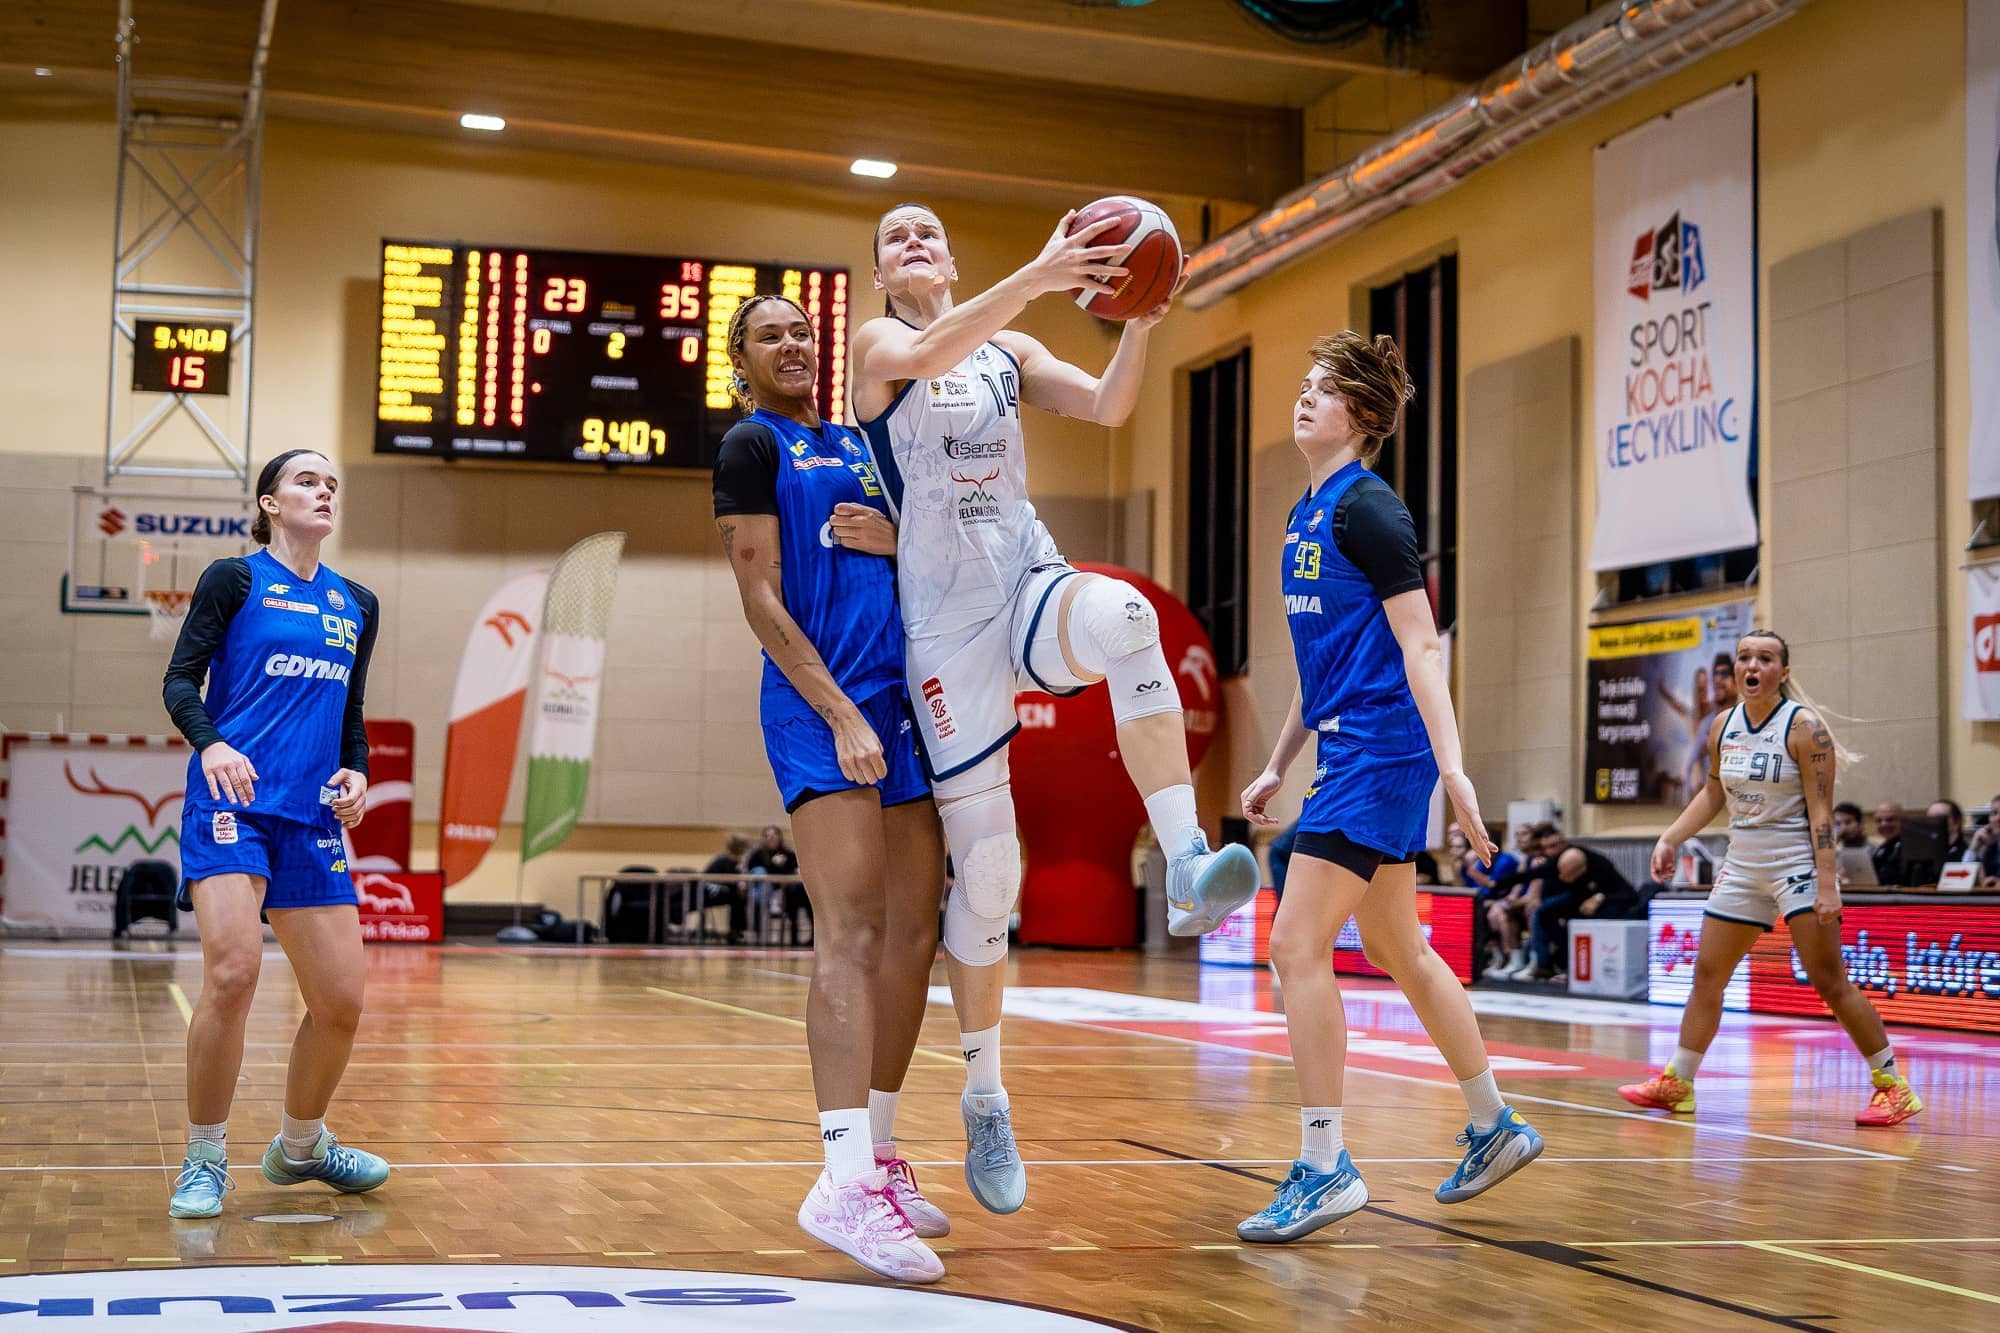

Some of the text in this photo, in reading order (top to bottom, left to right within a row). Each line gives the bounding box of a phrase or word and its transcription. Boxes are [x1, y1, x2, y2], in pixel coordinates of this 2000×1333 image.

[544, 277, 587, 313] 23
[660, 284, 700, 320] 35
[533, 328, 551, 354] 0
[607, 332, 625, 359] 2
[681, 337, 699, 363] 0
[1630, 302, 1711, 368] SPORT
[170, 356, 205, 389] 15
[1625, 357, 1713, 416] KOCHA
[849, 462, 882, 496] 2
[135, 513, 249, 537] SUZUK
[1293, 541, 1321, 579] 93
[322, 613, 358, 656] 95
[1749, 752, 1783, 784] 91
[1309, 1119, 1333, 1129] 4F
[0, 1288, 795, 1315] SUZUK
